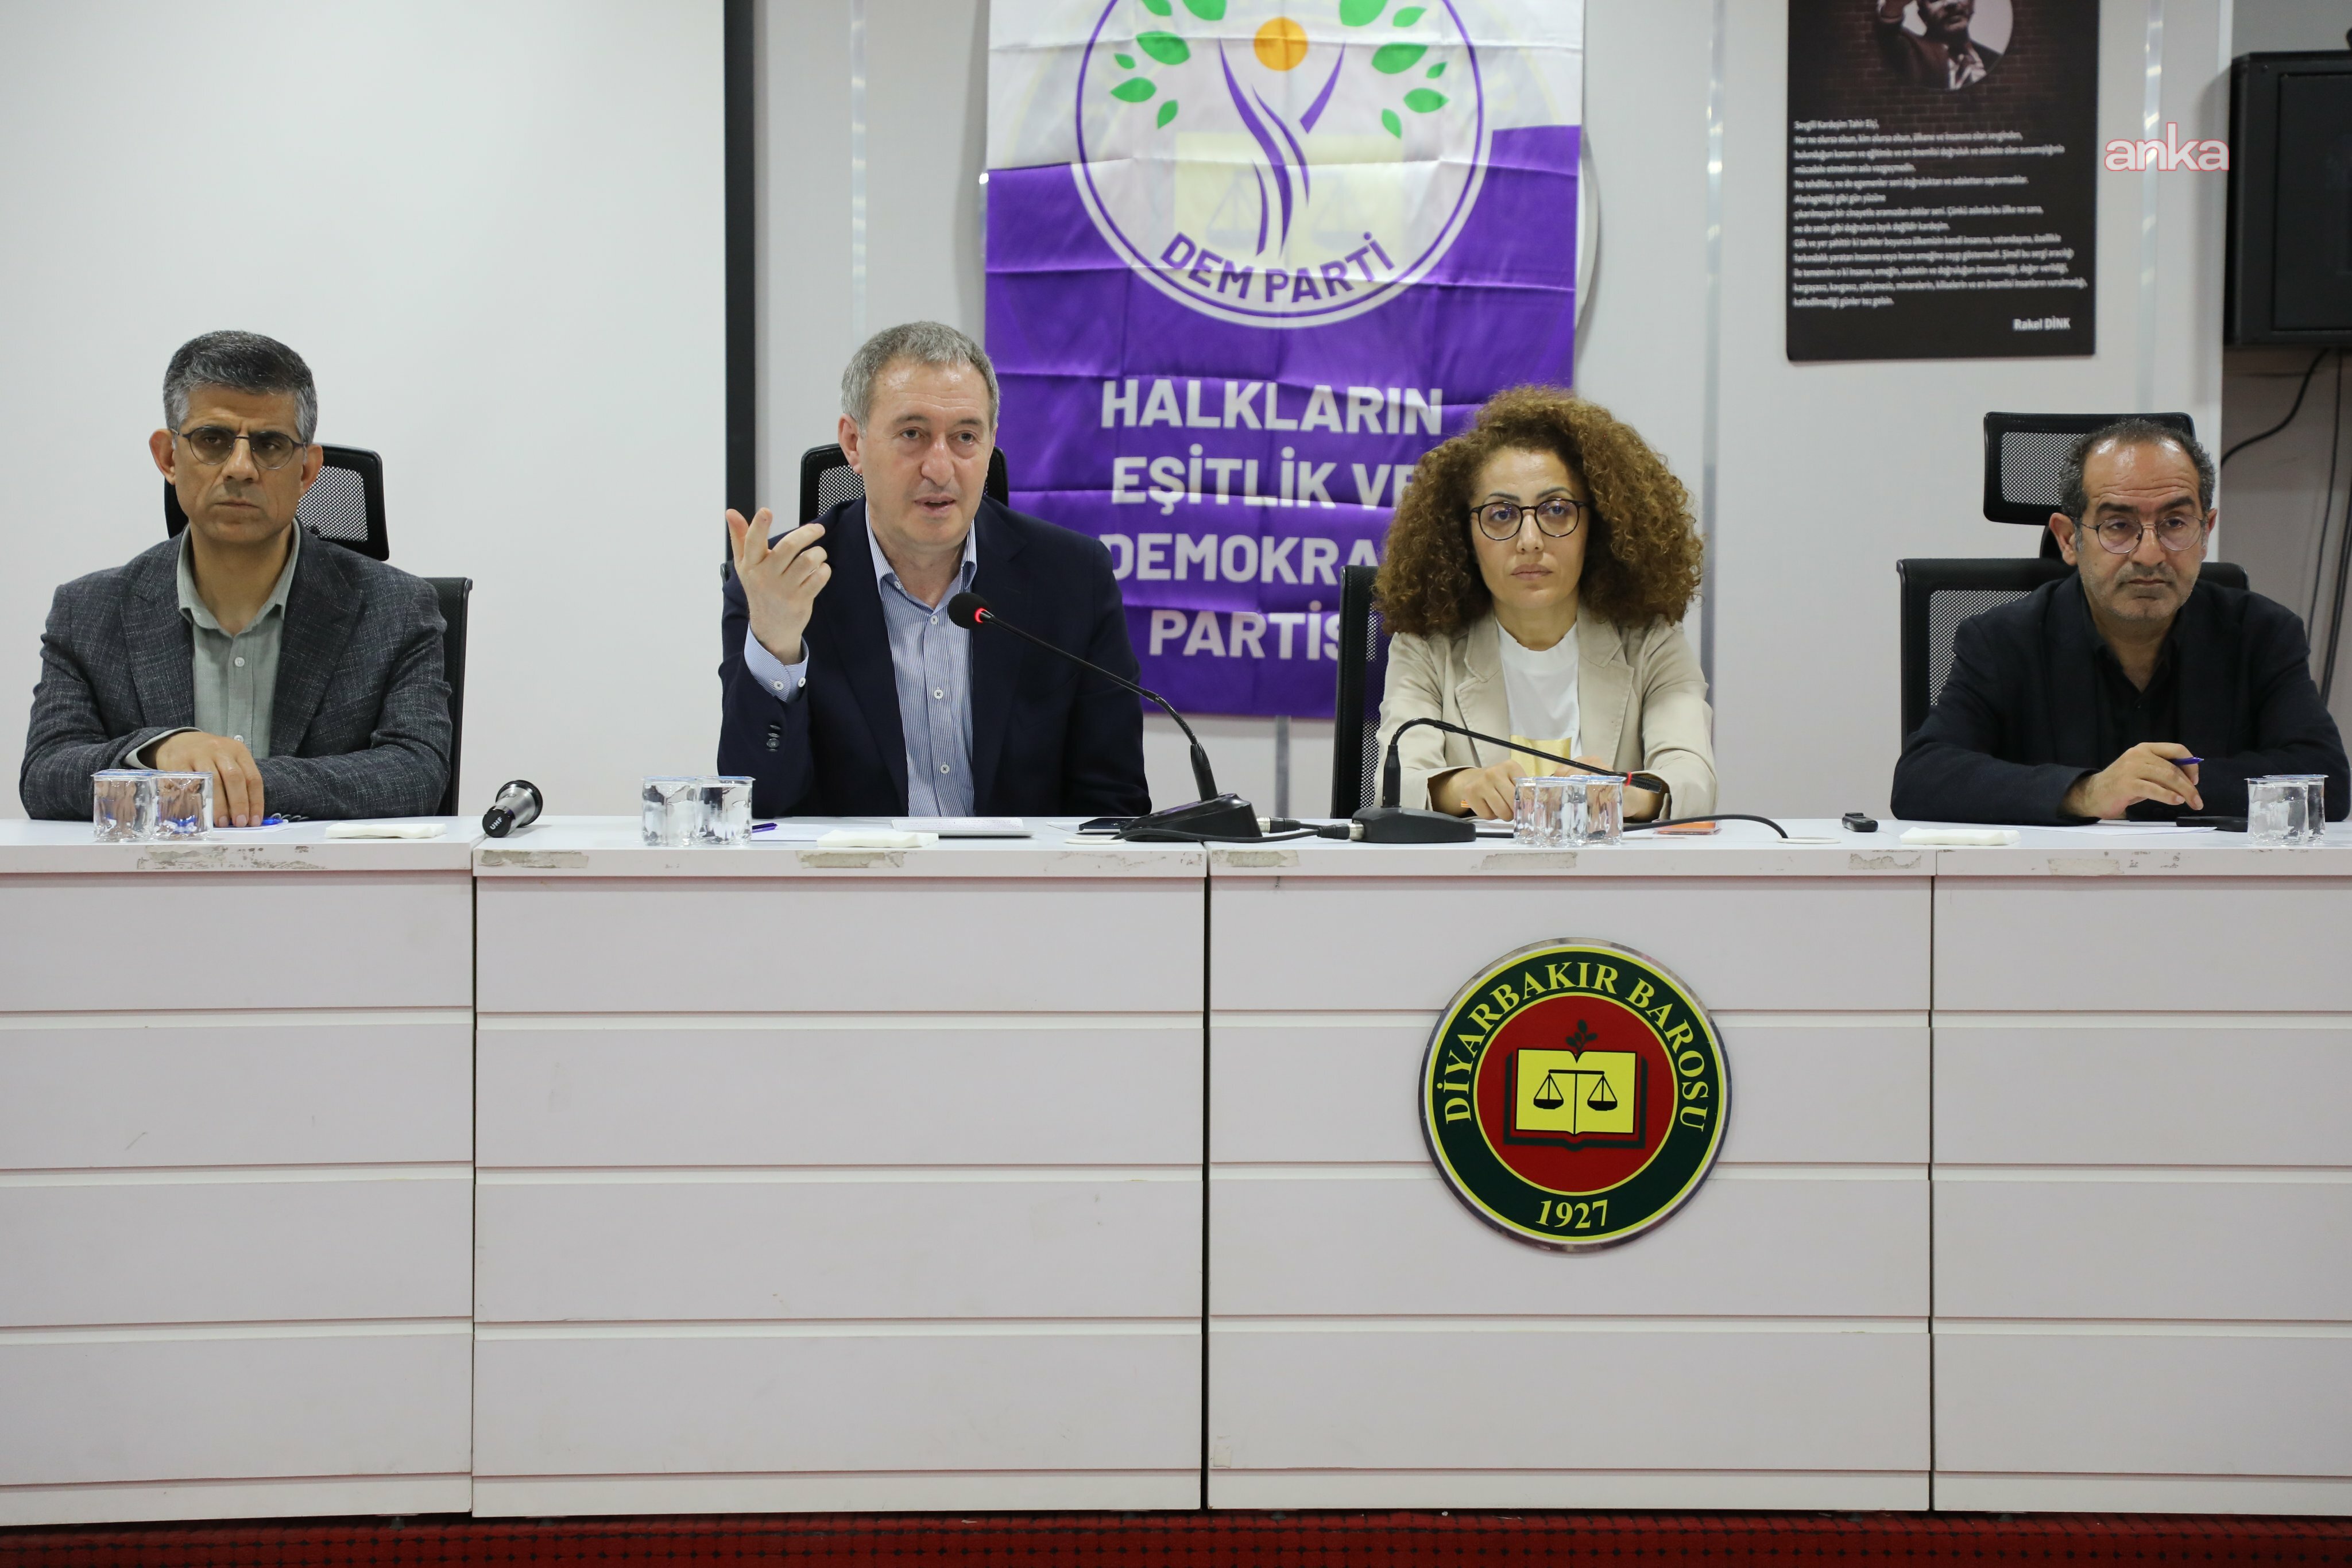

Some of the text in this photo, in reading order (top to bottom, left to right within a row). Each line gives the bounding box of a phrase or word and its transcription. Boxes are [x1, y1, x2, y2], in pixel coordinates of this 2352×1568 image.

[1159, 231, 1395, 304] DEM PARTİ
[2012, 315, 2071, 331] Rakel DİNK
[1100, 378, 1443, 436] HALKLARIN
[1111, 444, 1337, 516] EŞİTLİK
[489, 816, 503, 830] UHF
[1437, 962, 1709, 1132] DİYARBAKIR BAROSU
[1535, 1199, 1608, 1229] 1927
